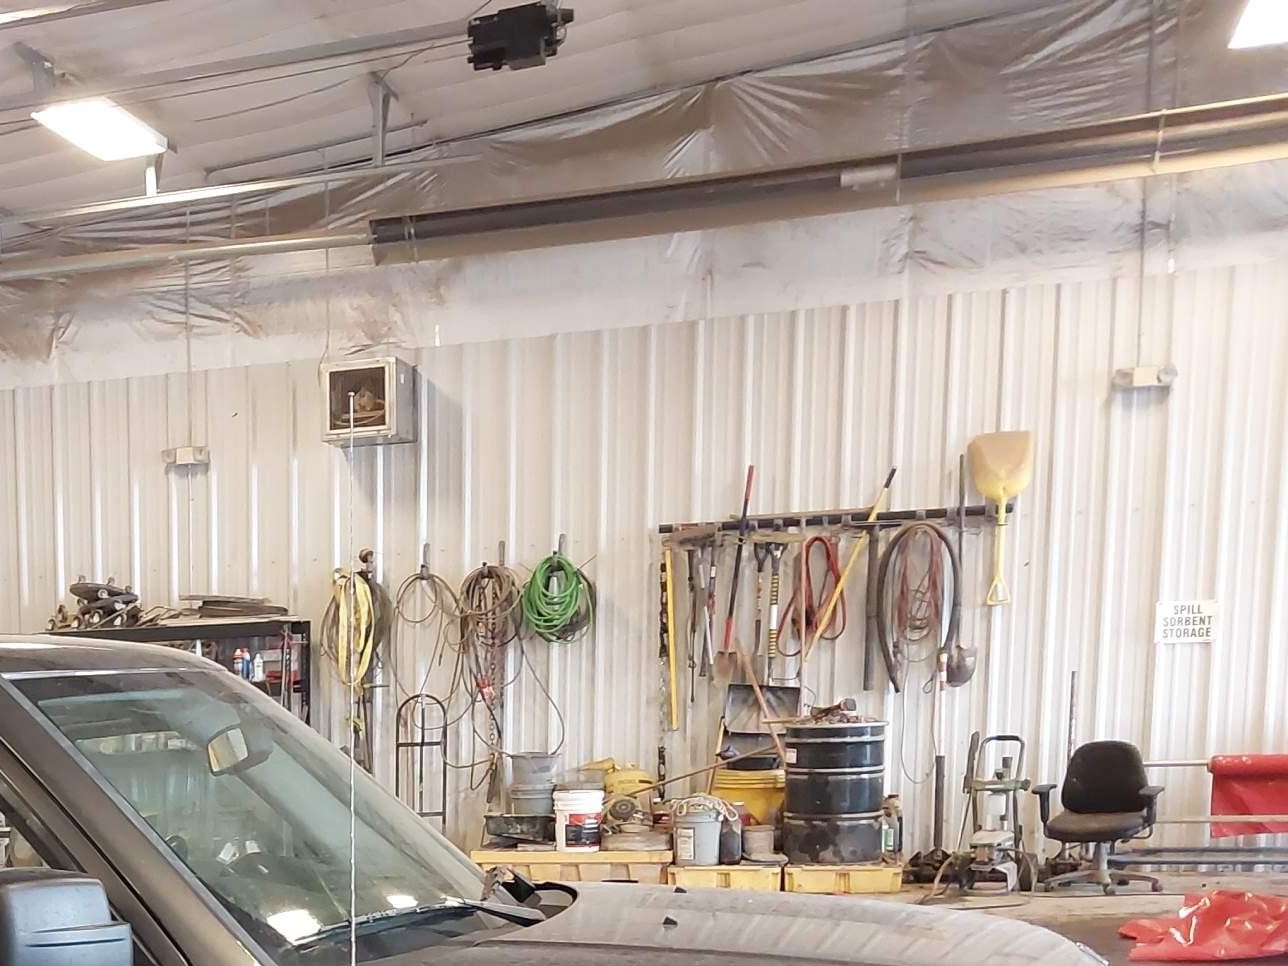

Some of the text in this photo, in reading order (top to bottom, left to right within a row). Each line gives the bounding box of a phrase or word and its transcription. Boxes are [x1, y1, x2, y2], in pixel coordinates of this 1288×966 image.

[1173, 604, 1204, 615] SPILL
[1162, 616, 1213, 627] SORBENT
[1162, 627, 1212, 639] STORAGE
